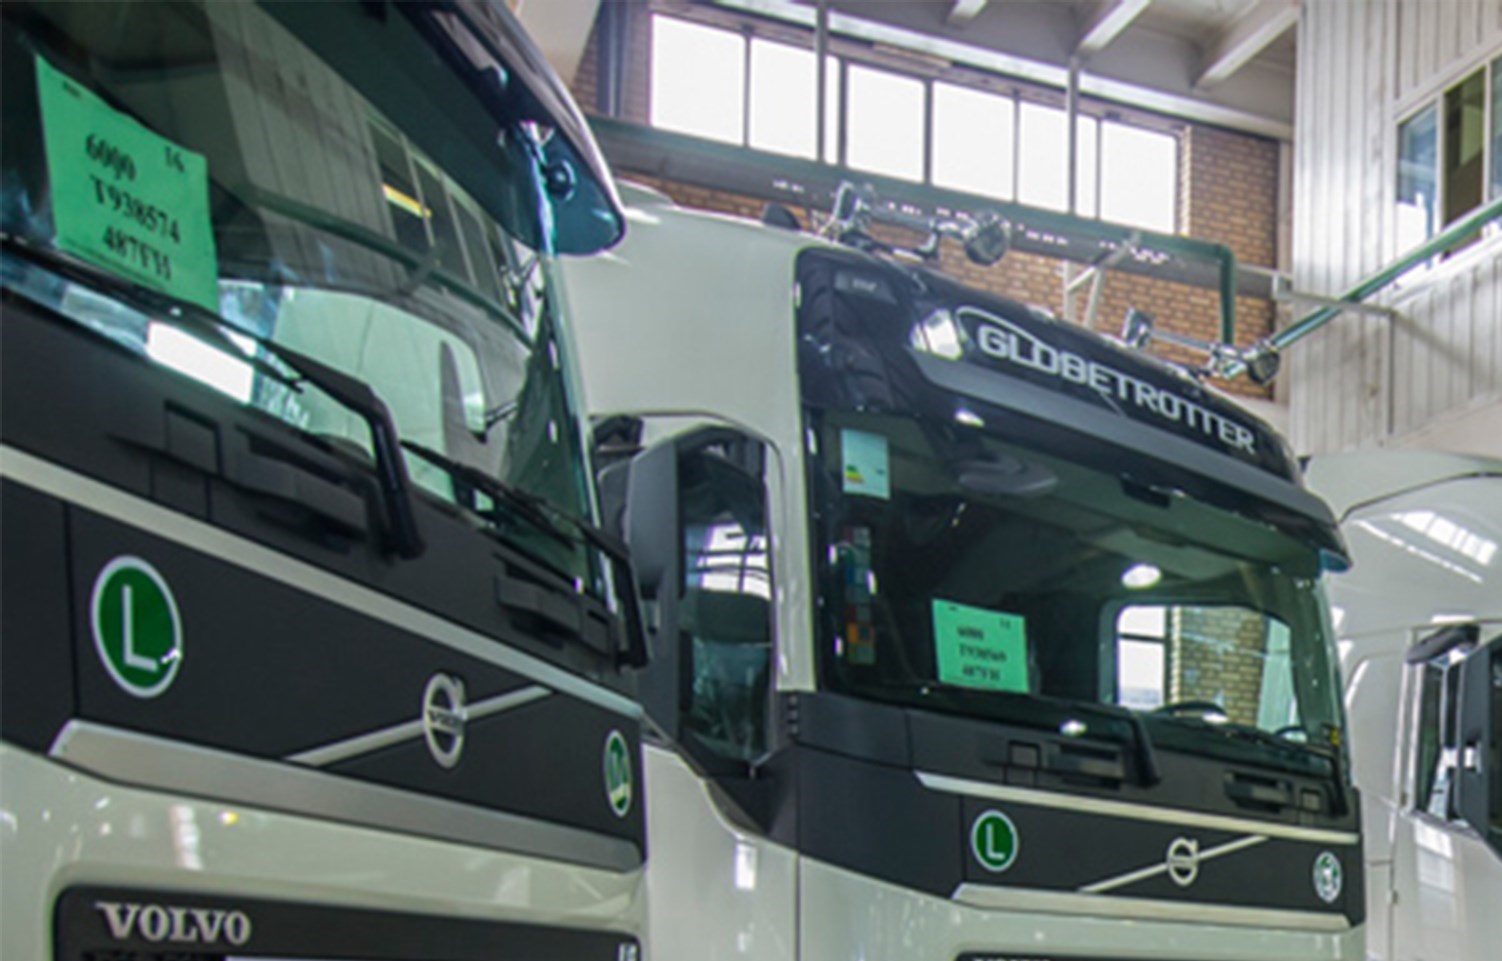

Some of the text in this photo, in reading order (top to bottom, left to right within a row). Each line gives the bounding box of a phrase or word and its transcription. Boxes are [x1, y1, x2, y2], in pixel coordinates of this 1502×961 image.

[977, 324, 1256, 454] GLOBETROTTER
[122, 584, 158, 672] L
[986, 822, 1005, 860] L
[95, 901, 252, 945] VOLVO
